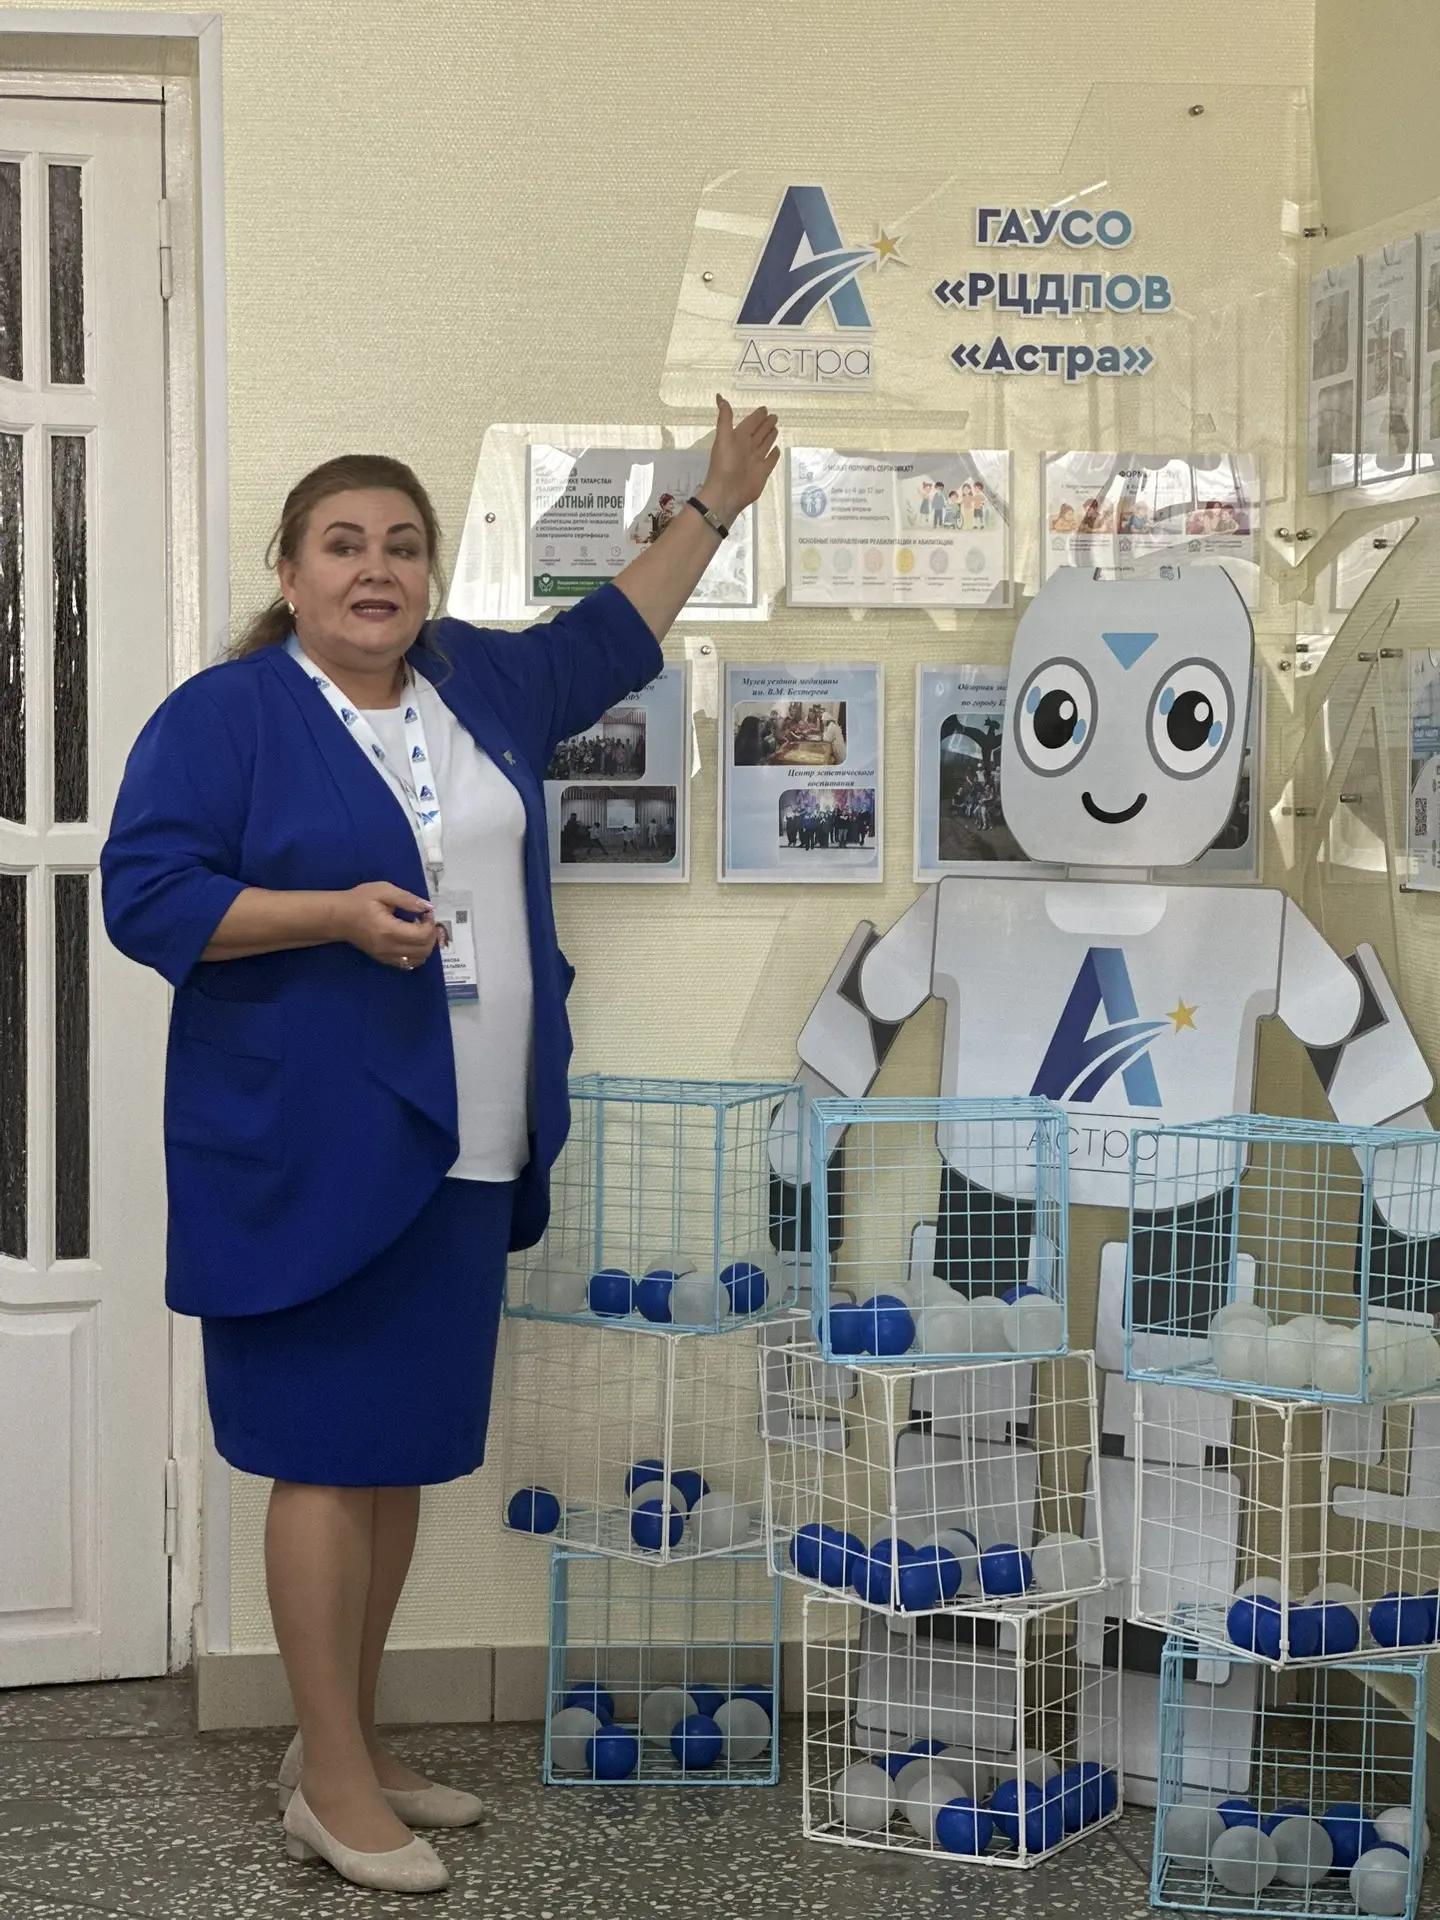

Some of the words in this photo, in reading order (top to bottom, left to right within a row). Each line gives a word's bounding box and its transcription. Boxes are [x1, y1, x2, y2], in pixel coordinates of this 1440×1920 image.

[976, 208, 1133, 247] ГАУСО
[934, 272, 1172, 317] «РЦДПОВ
[738, 339, 871, 380] Астра
[951, 336, 1154, 382] «Астра»
[596, 495, 625, 509] ПРОЕ
[742, 677, 766, 687] Музей
[799, 677, 839, 687] медицины
[957, 683, 994, 692] Обзорная
[767, 688, 785, 696] В.М.
[787, 688, 829, 697] Бехтерева
[787, 769, 815, 778] Центр
[817, 769, 875, 777] эстетического
